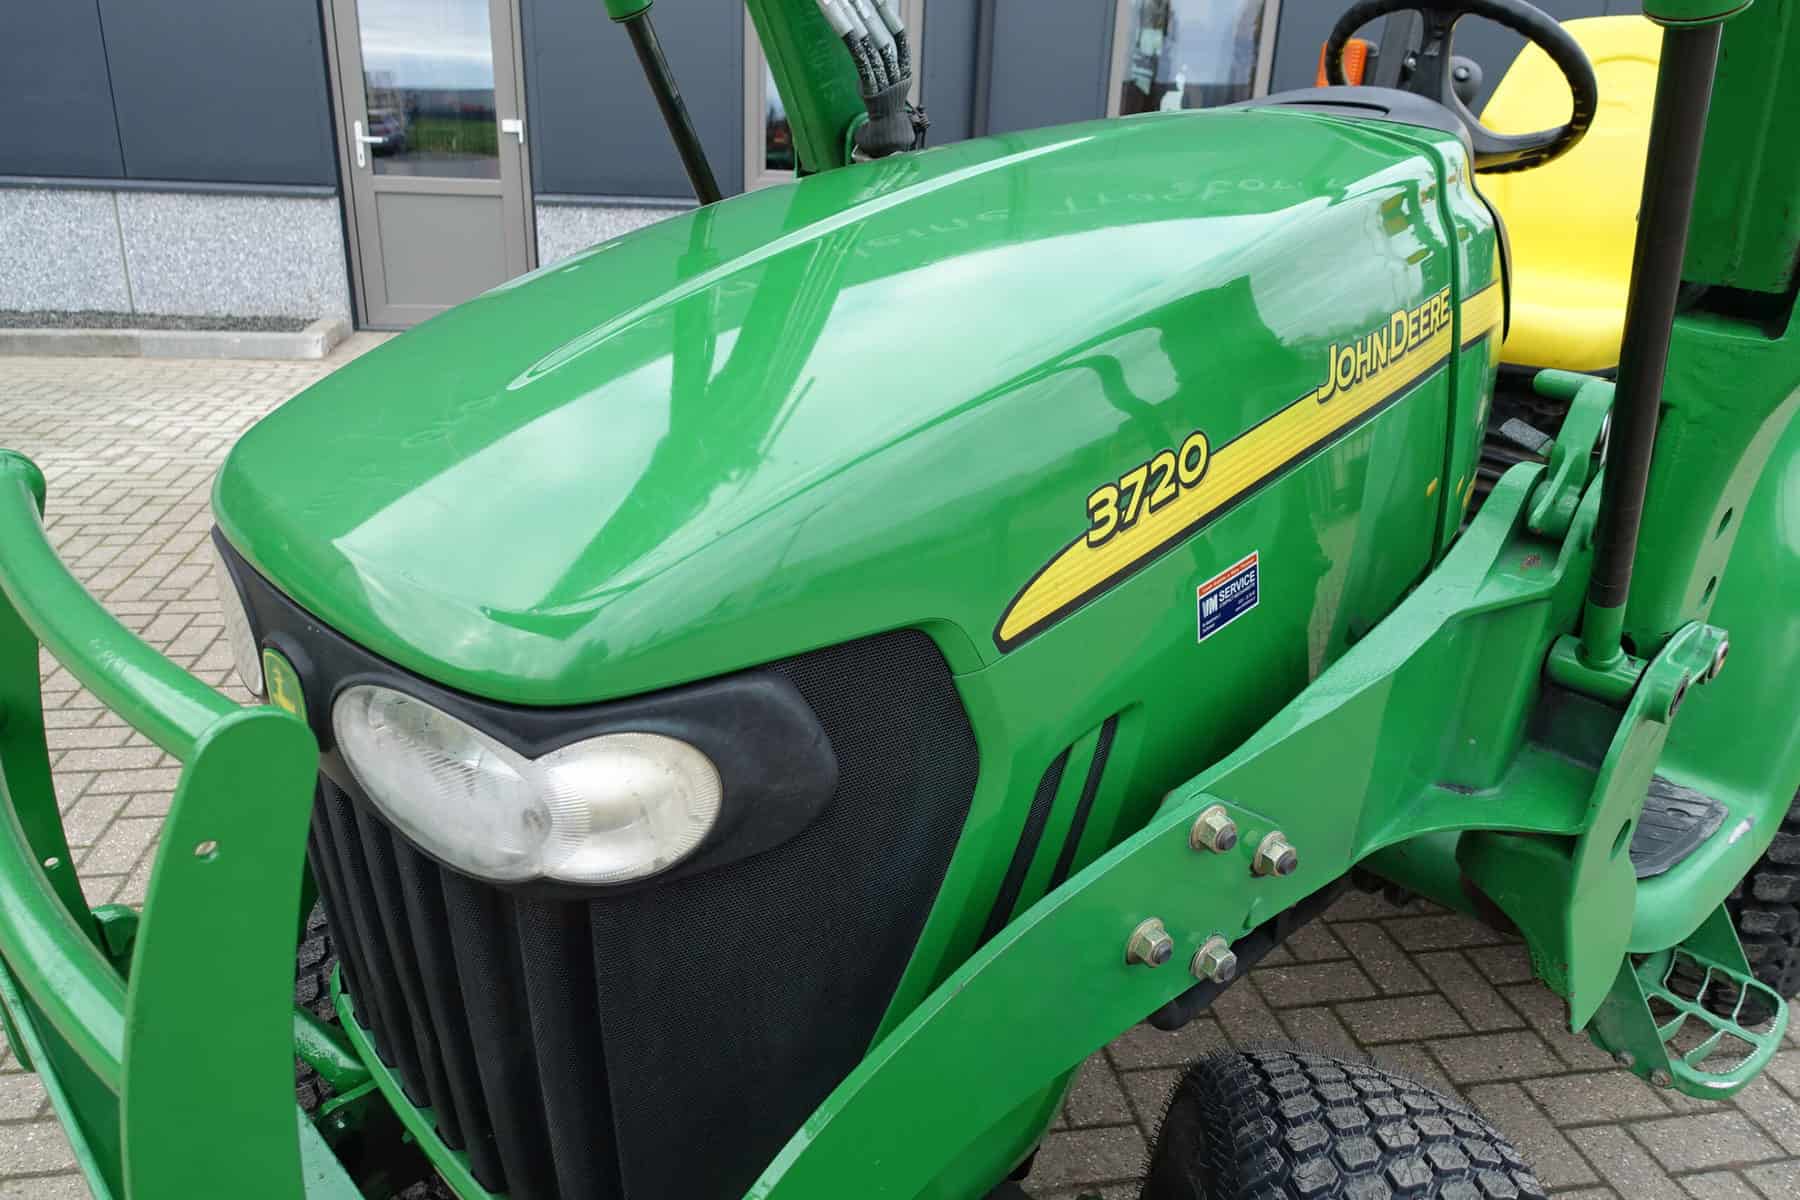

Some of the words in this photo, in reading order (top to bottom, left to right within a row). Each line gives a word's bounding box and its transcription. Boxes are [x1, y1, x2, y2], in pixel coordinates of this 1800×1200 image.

[1317, 324, 1389, 403] JOHN
[1390, 286, 1450, 362] DEERE
[1086, 430, 1210, 549] 3720
[1218, 570, 1256, 602] SERVICE
